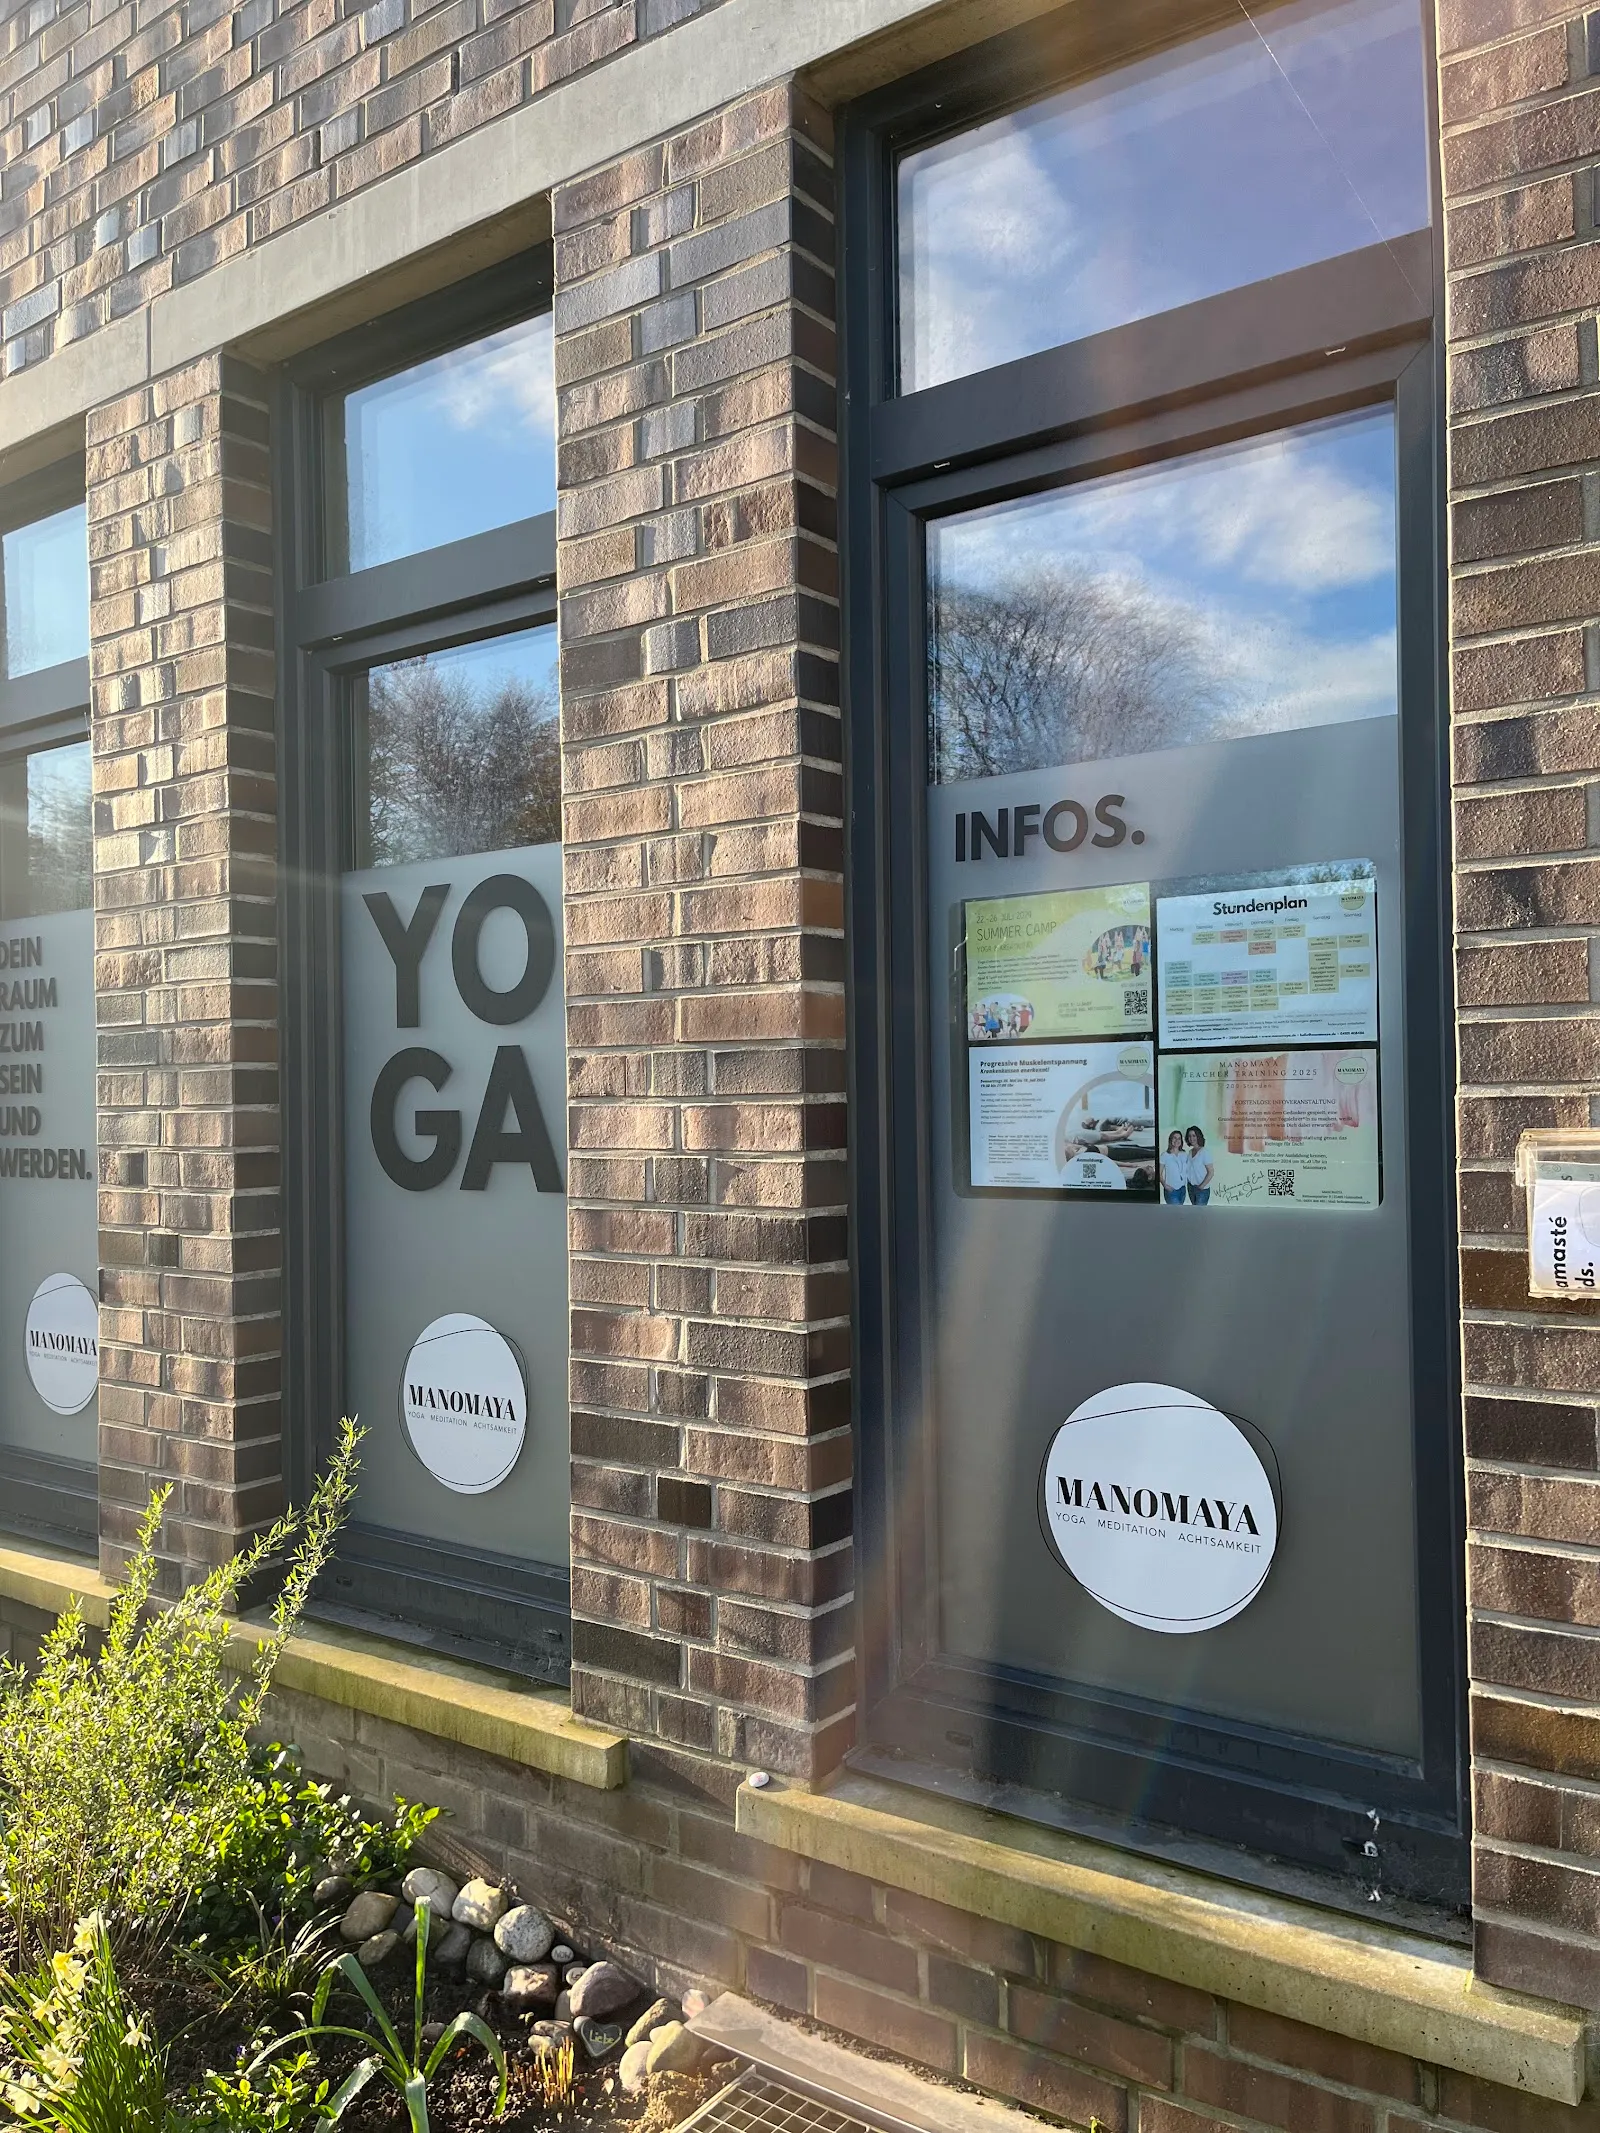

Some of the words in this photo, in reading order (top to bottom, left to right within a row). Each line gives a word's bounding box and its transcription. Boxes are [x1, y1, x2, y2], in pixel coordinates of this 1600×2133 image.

[955, 794, 1145, 862] INFOS.
[1212, 895, 1308, 916] Stundenplan
[976, 925, 1022, 942] SUMMER
[1026, 921, 1057, 937] CAMP
[362, 873, 556, 1029] YO
[0, 977, 58, 1011] RAUM
[0, 1021, 44, 1053] ZUM
[980, 1060, 1018, 1068] Progressive
[1019, 1059, 1088, 1067] Muskelentspannung
[1183, 1071, 1229, 1079] TEACHER
[1235, 1069, 1287, 1077] TRAINING
[1219, 1060, 1279, 1068] MANOMAYA
[0, 1064, 42, 1095] SEIN
[0, 1106, 41, 1136] UND
[370, 1045, 564, 1193] GA
[0, 1148, 92, 1180] WERDEN.
[29, 1330, 98, 1356] MANOMAYA
[408, 1384, 517, 1421] MANOMAYA
[407, 1411, 425, 1419] YOGA
[430, 1414, 468, 1426] MEDITATION
[473, 1422, 517, 1434] ACHTSAMKEIT
[1055, 1476, 1262, 1536] MANOMAYA
[1055, 1511, 1086, 1525] YOGA
[1097, 1519, 1166, 1539] MEDITATION
[1178, 1532, 1262, 1554] ACHTSAMKEIT
